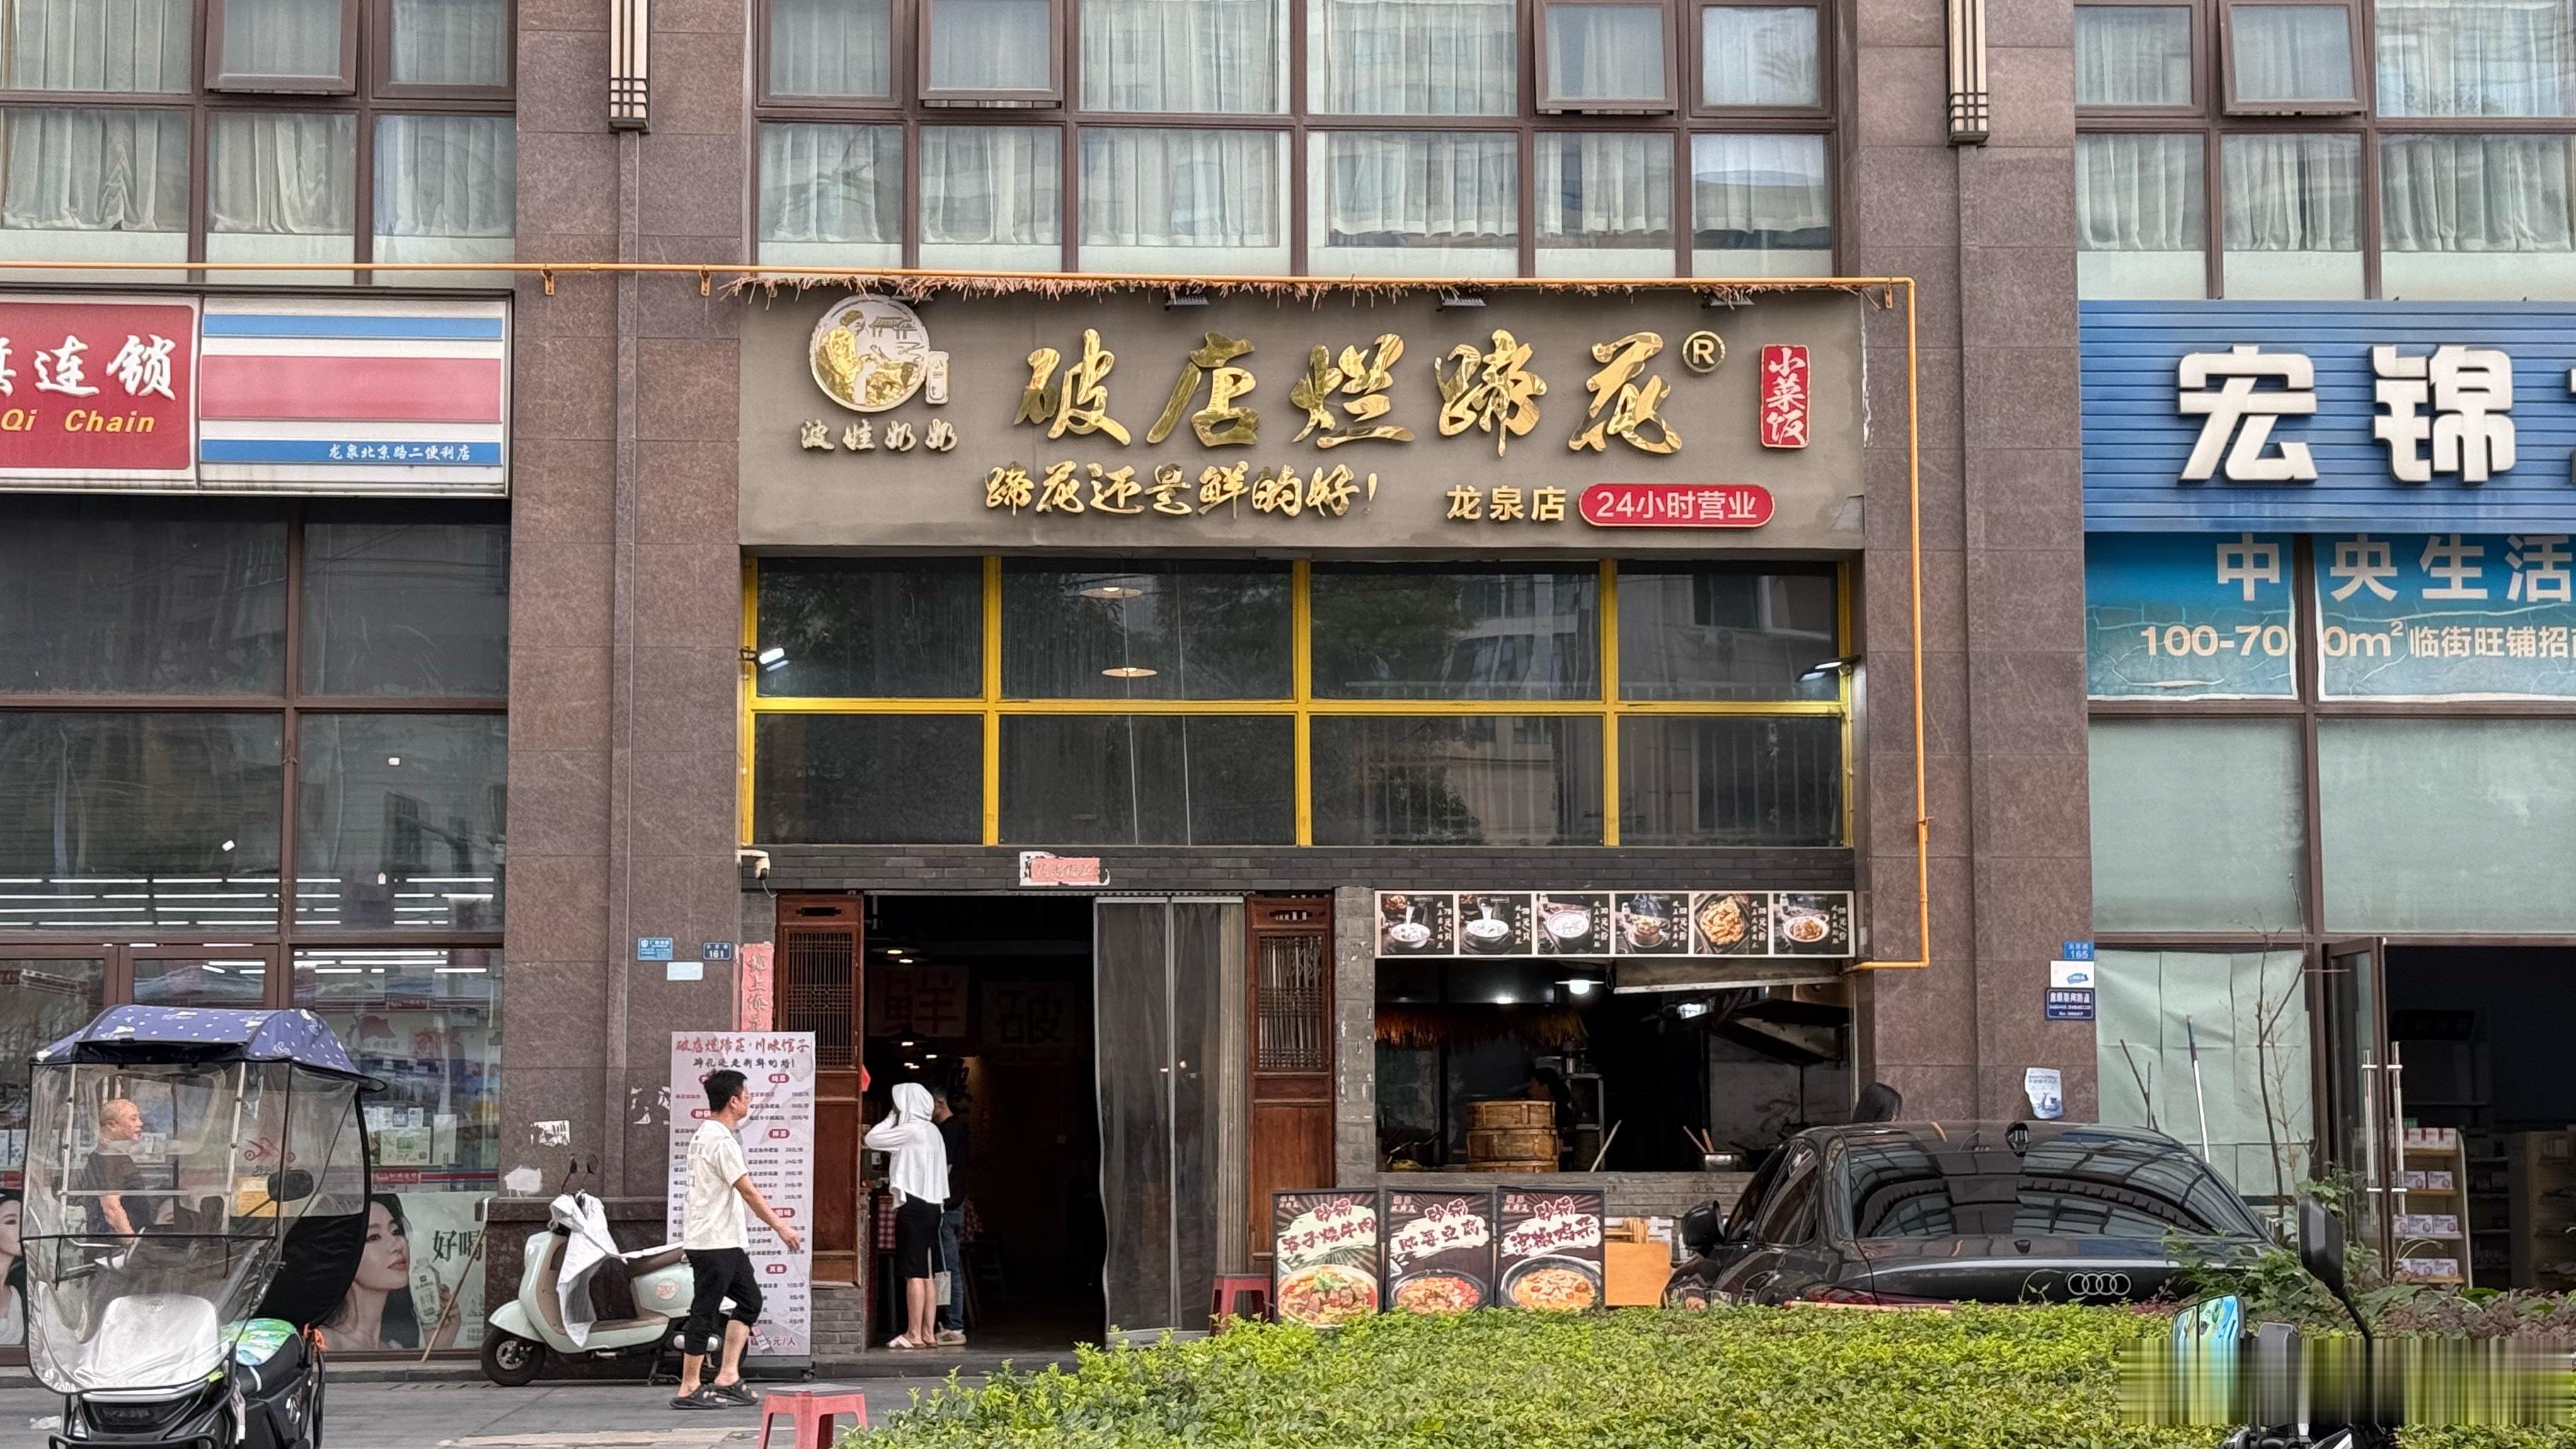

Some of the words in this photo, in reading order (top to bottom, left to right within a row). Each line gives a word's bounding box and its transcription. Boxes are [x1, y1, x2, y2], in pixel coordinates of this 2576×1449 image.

[1014, 328, 1683, 457] 破店烂蹄花
[1766, 348, 1807, 445] 小菜饭
[0, 408, 38, 432] Qi
[64, 409, 156, 433] Chain
[2178, 345, 2576, 483] 宏锦
[329, 443, 471, 462] 龙泉北京路二便利店
[1447, 484, 1565, 522] 龙泉店
[1596, 493, 1758, 521] 24小时营业
[2216, 534, 2572, 602] 中央生活
[2071, 950, 2088, 958] 165
